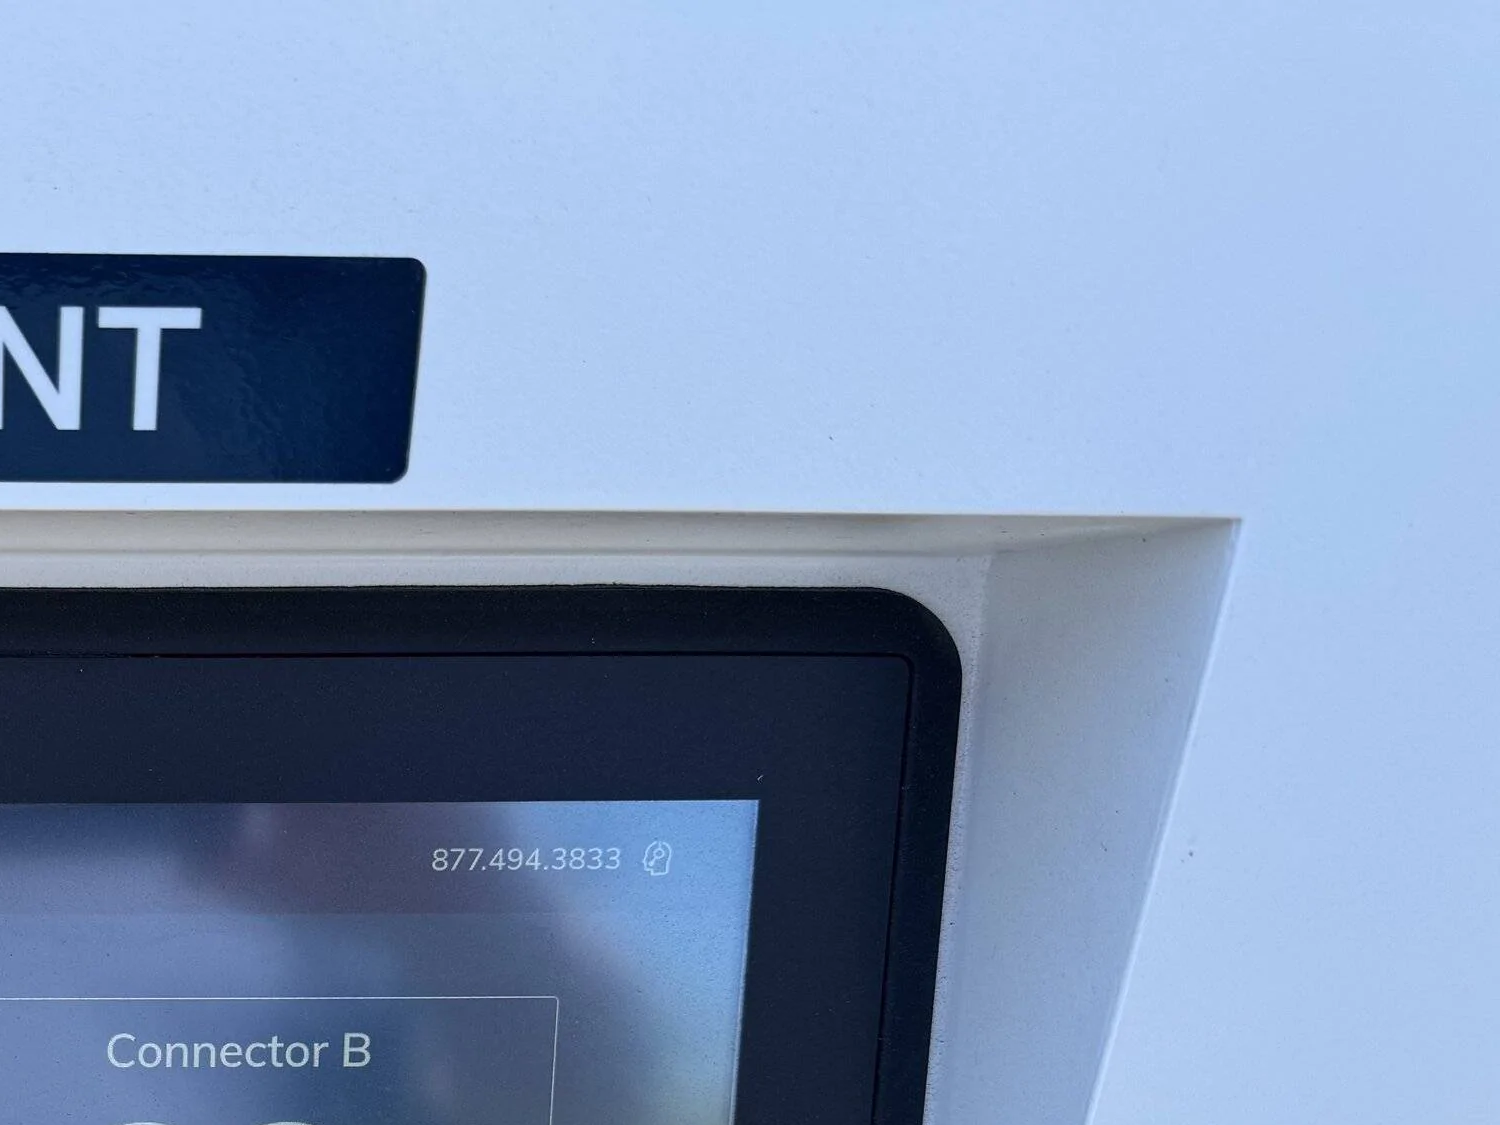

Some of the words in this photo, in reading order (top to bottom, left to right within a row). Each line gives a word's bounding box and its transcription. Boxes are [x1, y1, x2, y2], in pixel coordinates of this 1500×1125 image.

[431, 847, 621, 872] 877.494.3833
[106, 1031, 330, 1069] Connector
[343, 1033, 371, 1068] B
